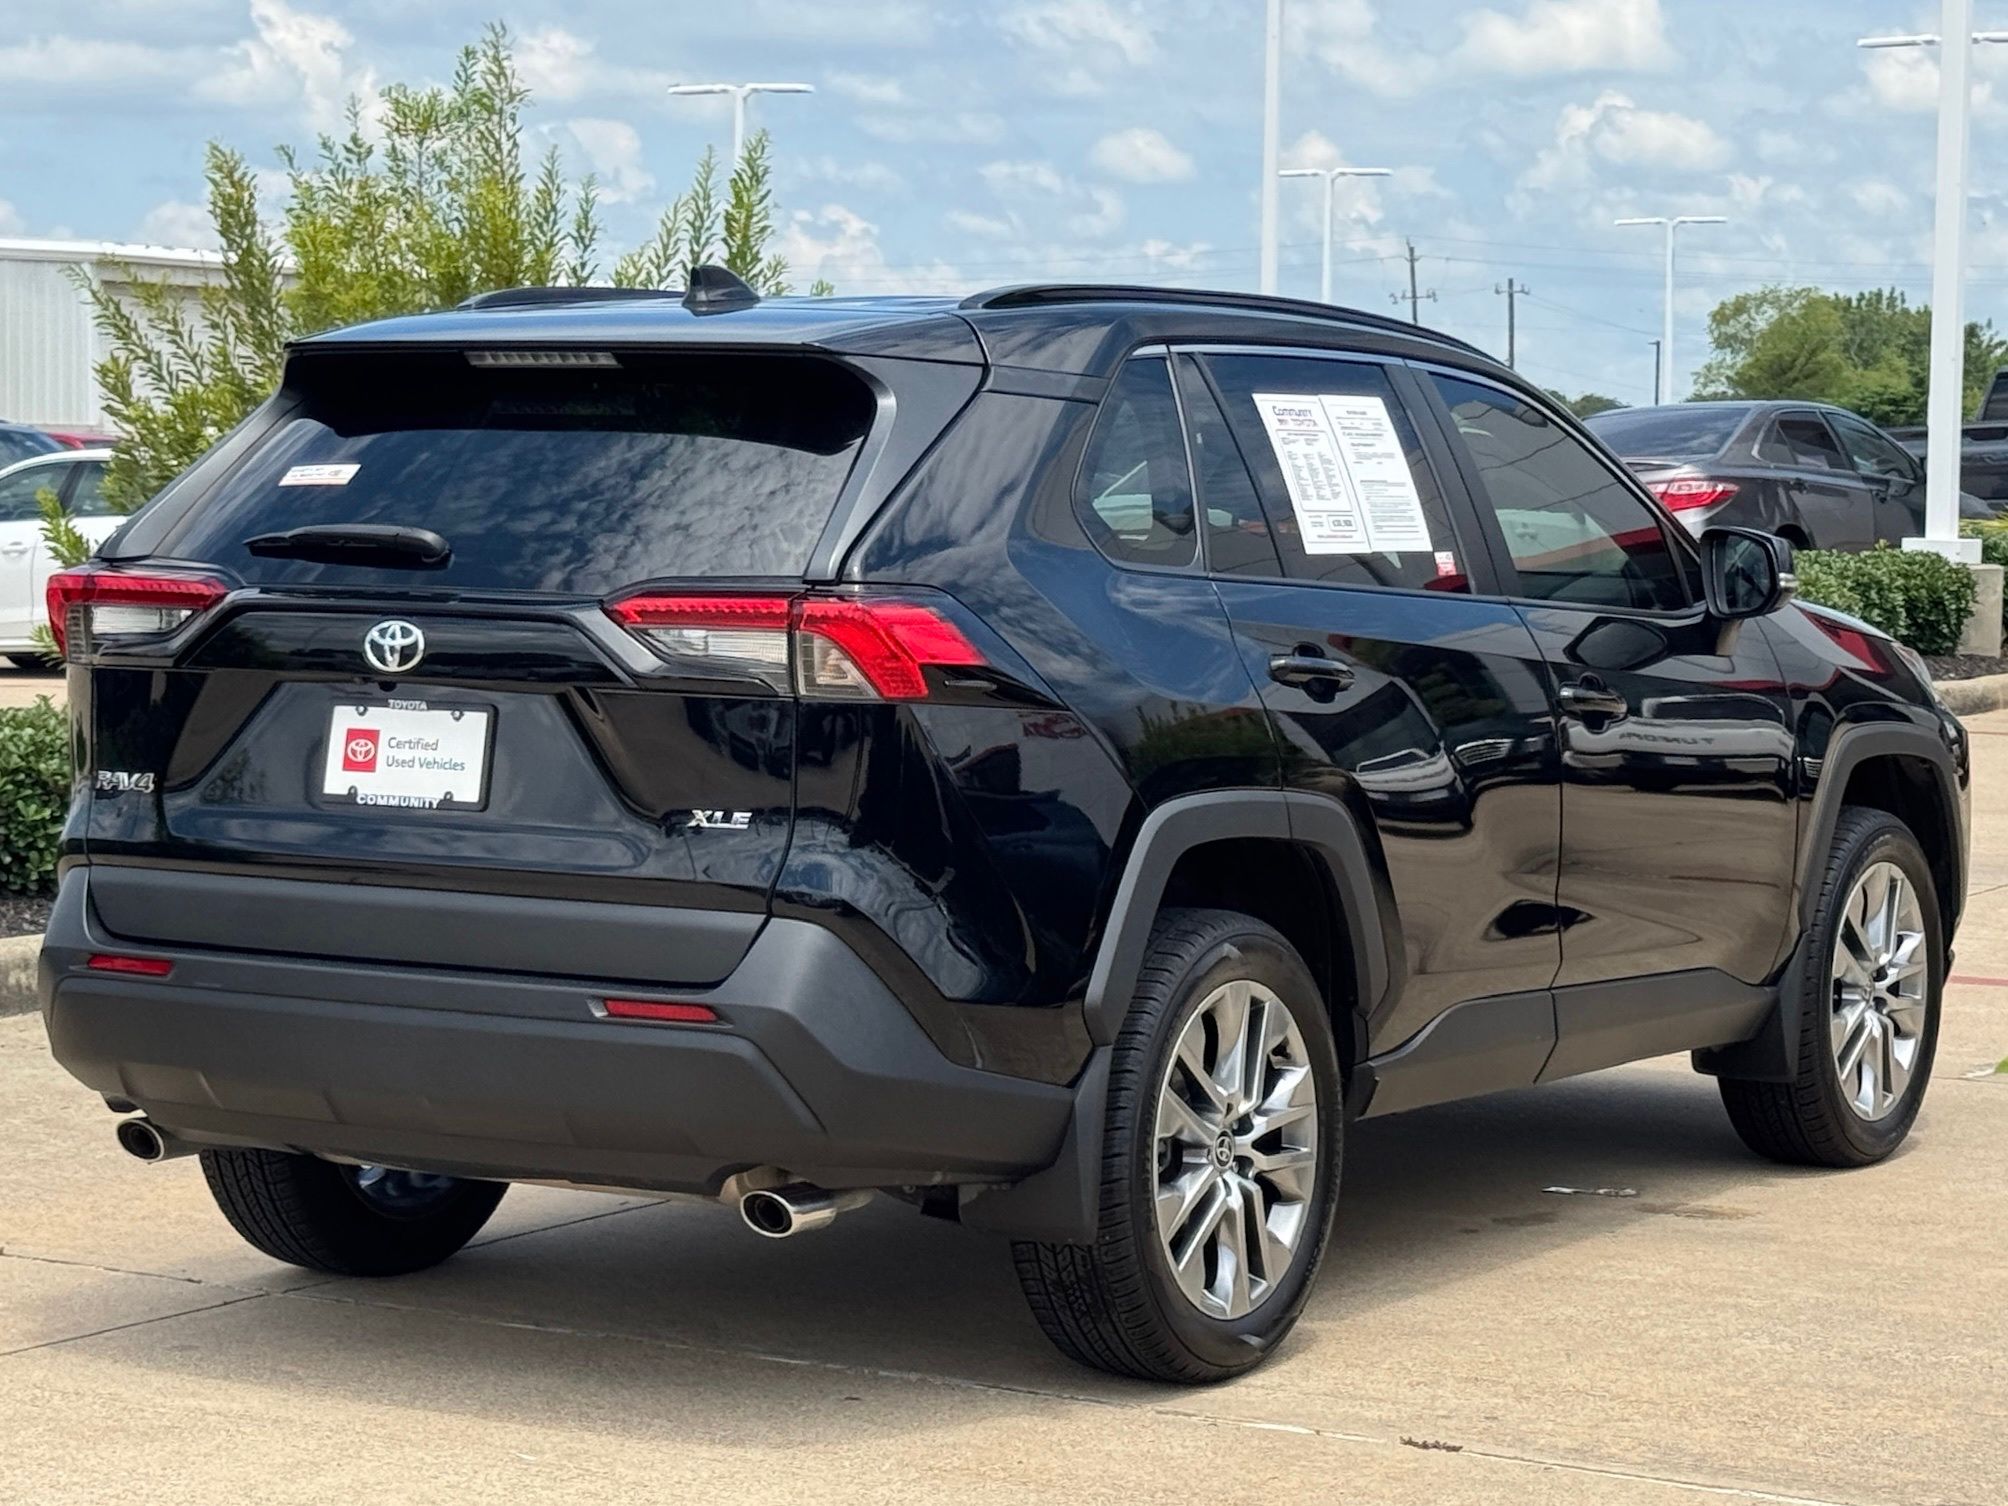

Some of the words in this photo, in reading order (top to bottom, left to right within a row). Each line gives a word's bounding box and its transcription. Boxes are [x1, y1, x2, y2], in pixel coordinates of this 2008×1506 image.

[388, 699, 428, 711] TOYOTA
[387, 737, 439, 751] Certified
[386, 755, 415, 768] Used
[419, 757, 466, 771] Vehicles
[95, 769, 155, 793] RAV4
[356, 793, 441, 809] COMMUNITY
[686, 809, 752, 830] XLE
